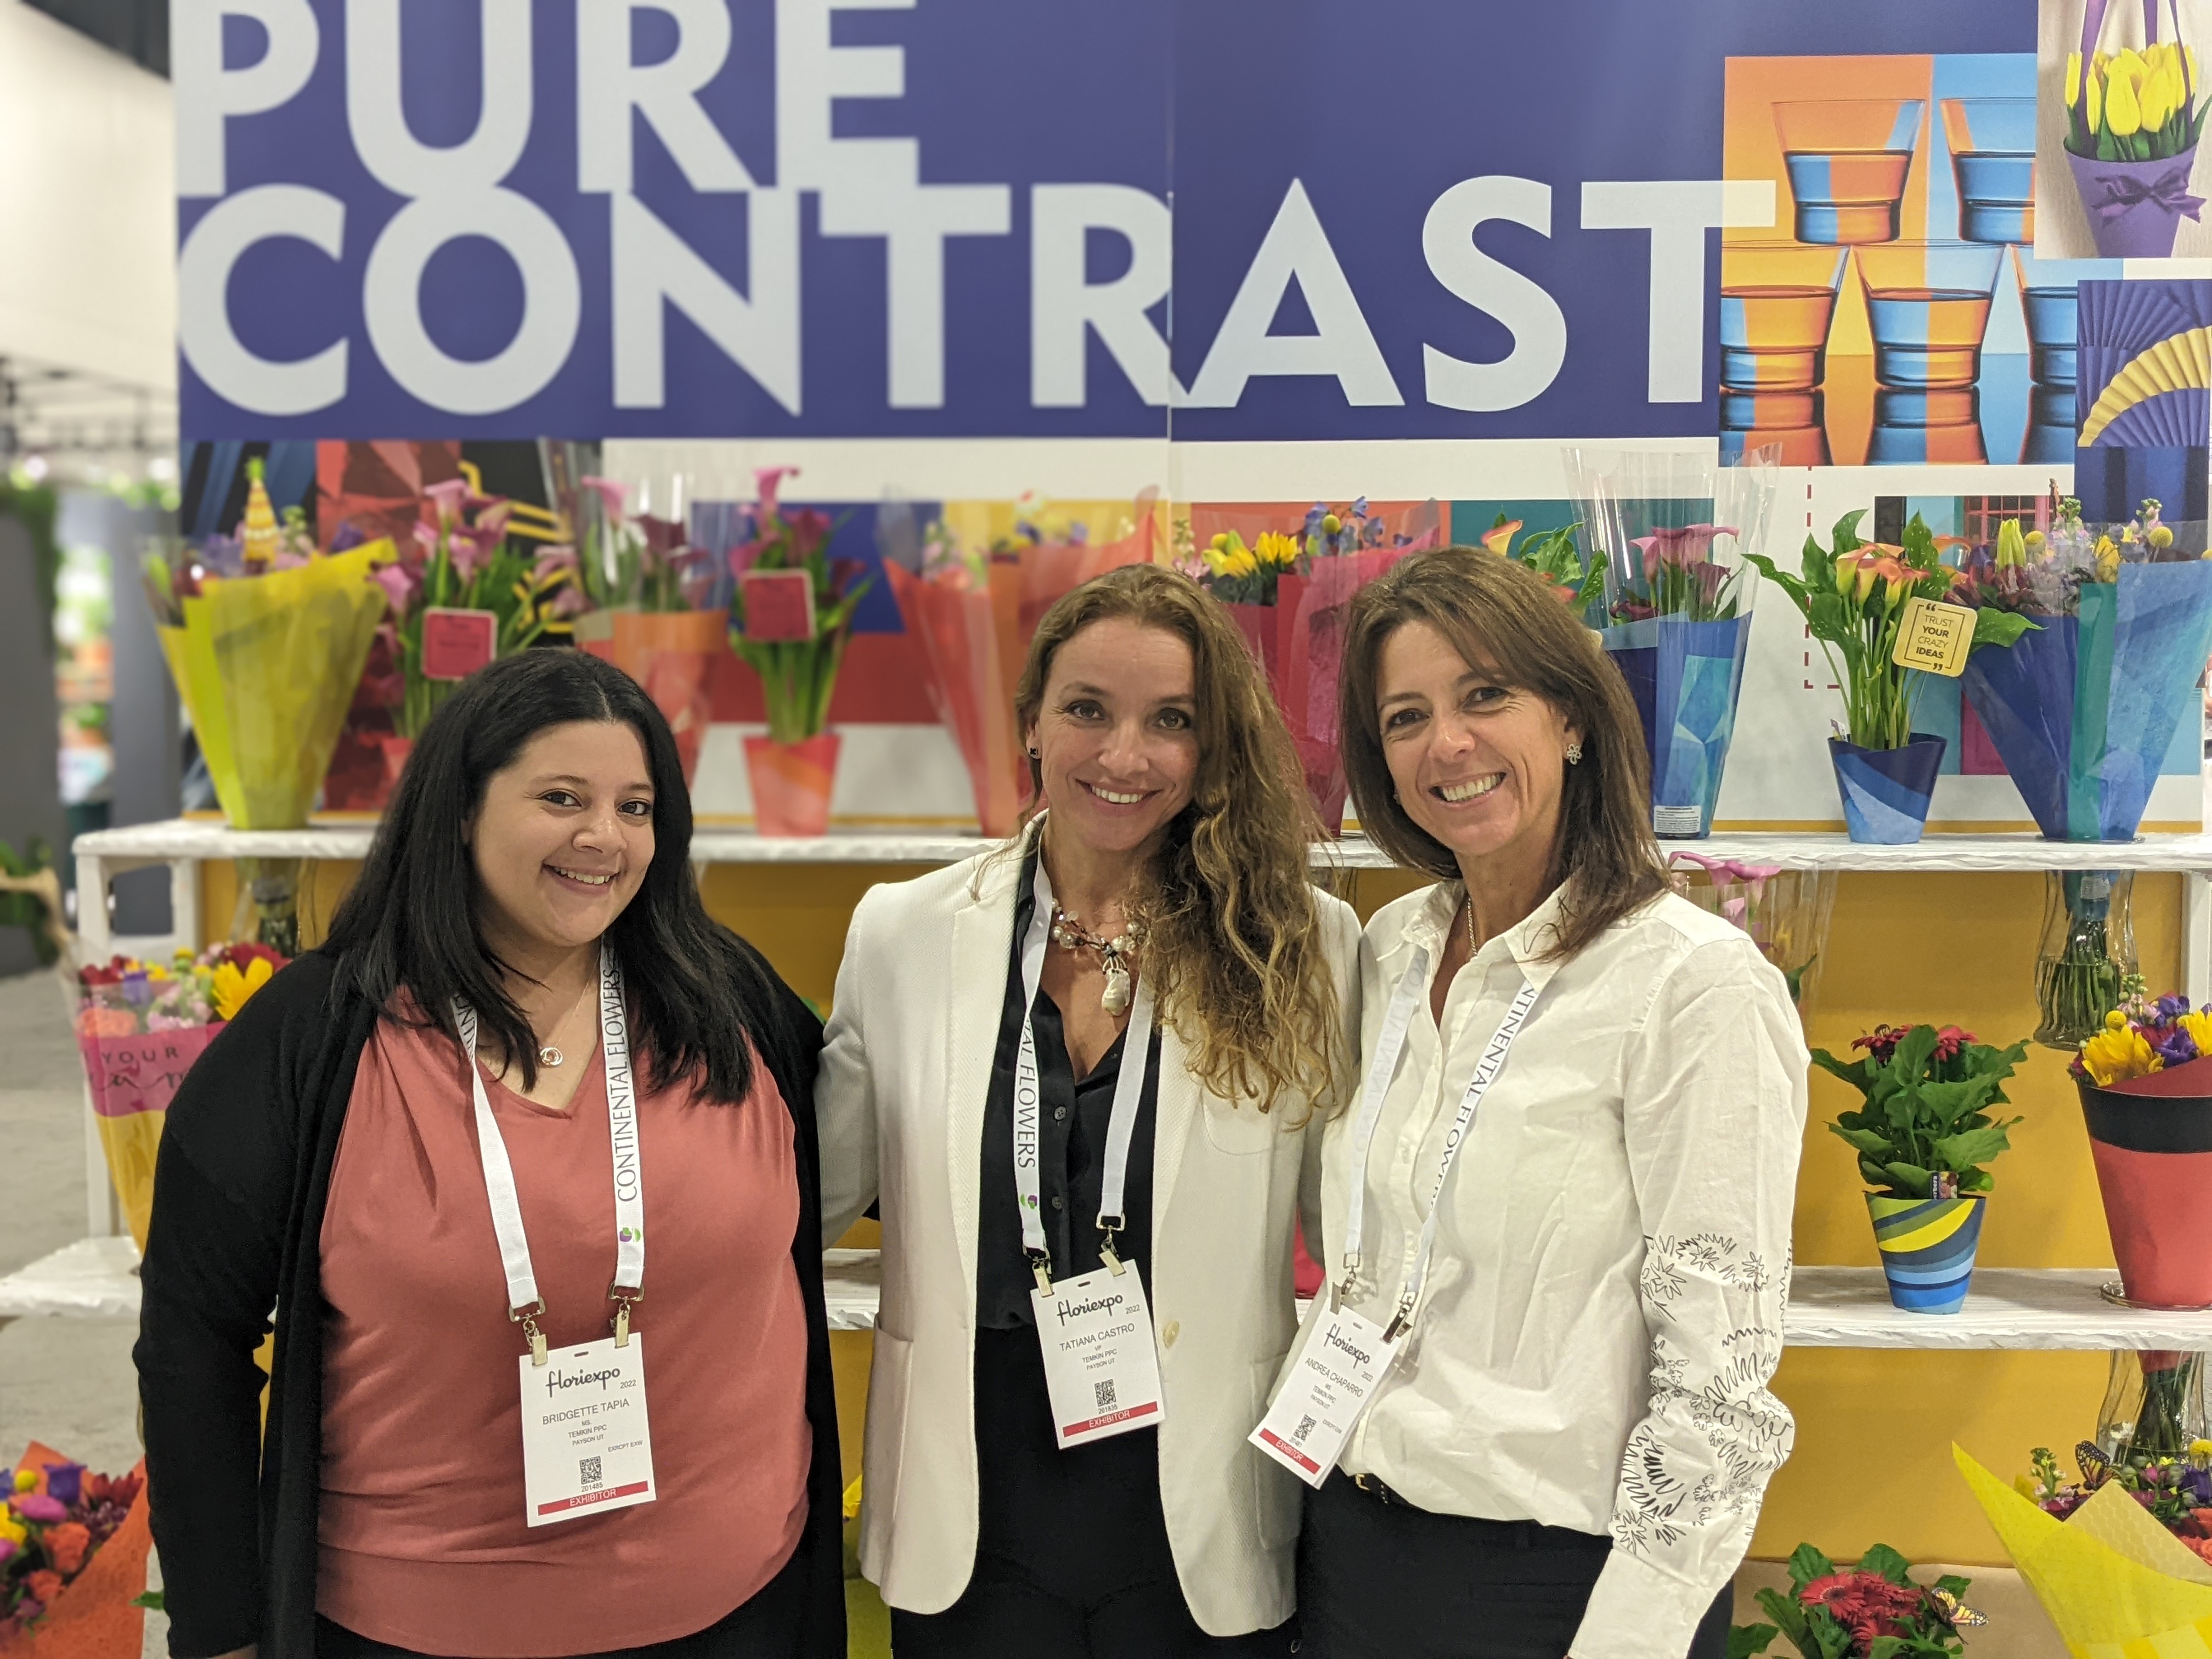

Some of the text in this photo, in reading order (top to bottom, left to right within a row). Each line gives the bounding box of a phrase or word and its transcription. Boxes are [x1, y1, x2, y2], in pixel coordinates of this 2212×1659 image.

[173, 0, 919, 199] PURE
[177, 175, 1776, 416] CONTRAST
[1923, 625, 1949, 638] YOUR
[1925, 614, 1954, 627] TRUST
[1916, 646, 1944, 659] IDEAS
[1918, 636, 1949, 648] CRAZY
[102, 1047, 178, 1064] YOUR
[603, 969, 637, 1203] CONTINENTAL FLOWERS
[1017, 1064, 1036, 1169] FLOWERS
[1057, 1294, 1141, 1327] floriexpo 2022
[1059, 1323, 1135, 1352] TATIANA CASTRO
[1323, 1323, 1370, 1369] floriexpo
[545, 1368, 636, 1398] floriexpo 2022
[1305, 1357, 1363, 1397] ANDREA CHAPARRO
[542, 1398, 630, 1425] BRIDGETTE TAPIA
[1089, 1410, 1131, 1428] EXHIBITOR
[594, 1424, 607, 1432] PPC
[572, 1436, 595, 1446] PAYSON
[1276, 1440, 1304, 1462] EXHIBITOR
[569, 1488, 617, 1506] EXHIBITOR
